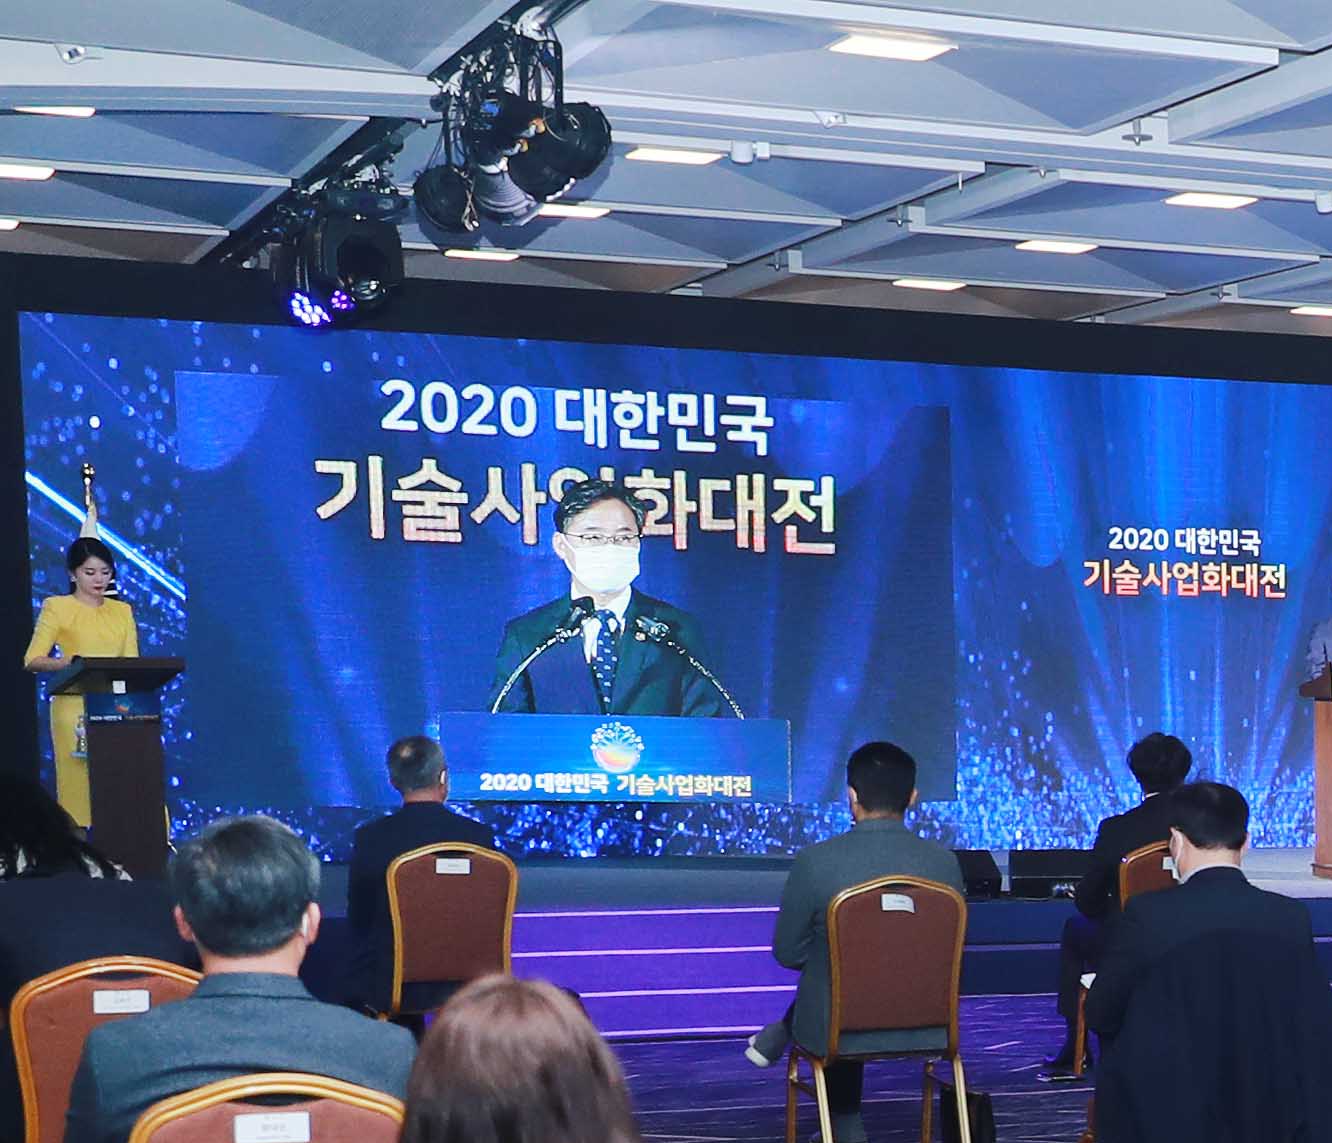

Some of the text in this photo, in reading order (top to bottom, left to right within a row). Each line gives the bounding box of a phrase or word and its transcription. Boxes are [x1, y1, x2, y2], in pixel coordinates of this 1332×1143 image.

[380, 379, 775, 457] 2020 대한민국
[1108, 526, 1262, 557] 2020 대한민국
[1083, 559, 1286, 599] 기술사업화대전
[479, 772, 752, 798] 2020 대한민국 기술사업화대전
